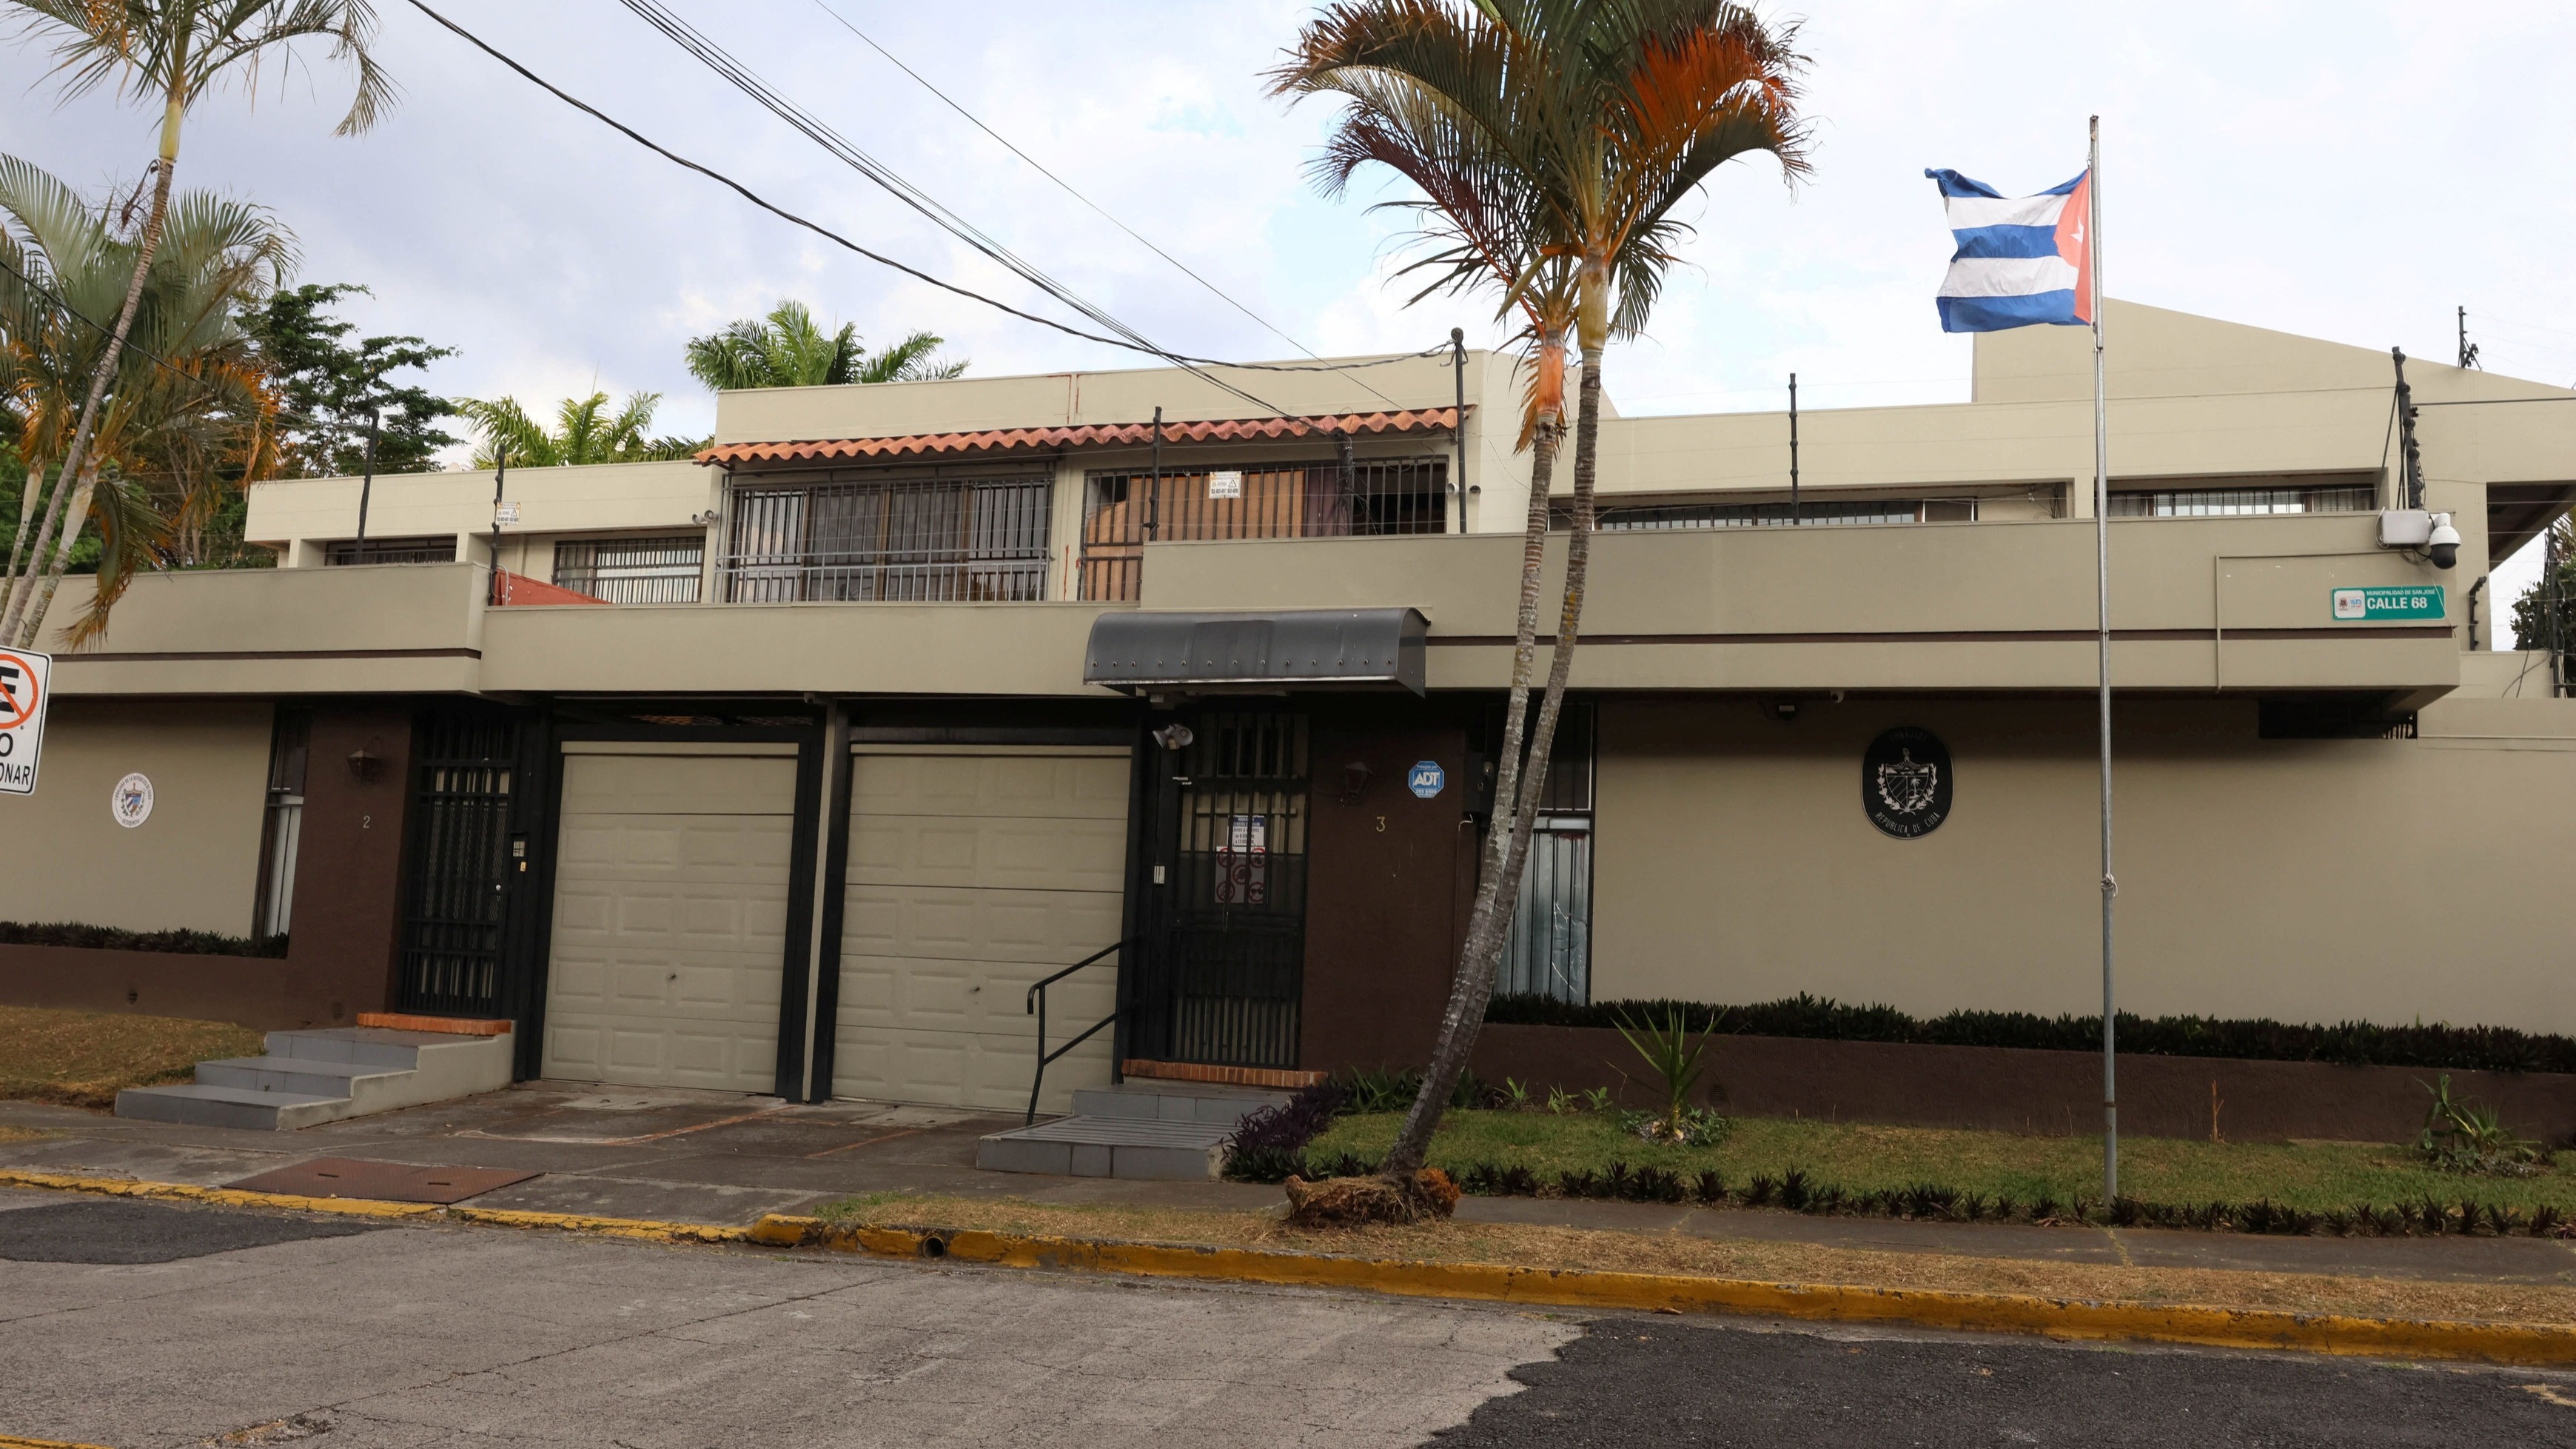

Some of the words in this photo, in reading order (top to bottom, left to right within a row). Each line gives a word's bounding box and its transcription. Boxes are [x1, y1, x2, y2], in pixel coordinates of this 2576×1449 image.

[2367, 598, 2408, 609] CALLE
[2411, 597, 2428, 609] 68
[0, 732, 13, 757] O
[1414, 772, 1440, 786] ADT
[363, 815, 370, 829] 2
[1376, 816, 1385, 832] 3
[1875, 812, 1908, 834] REPUBLICA
[1913, 823, 1922, 834] DE
[1925, 812, 1942, 827] CUBA
